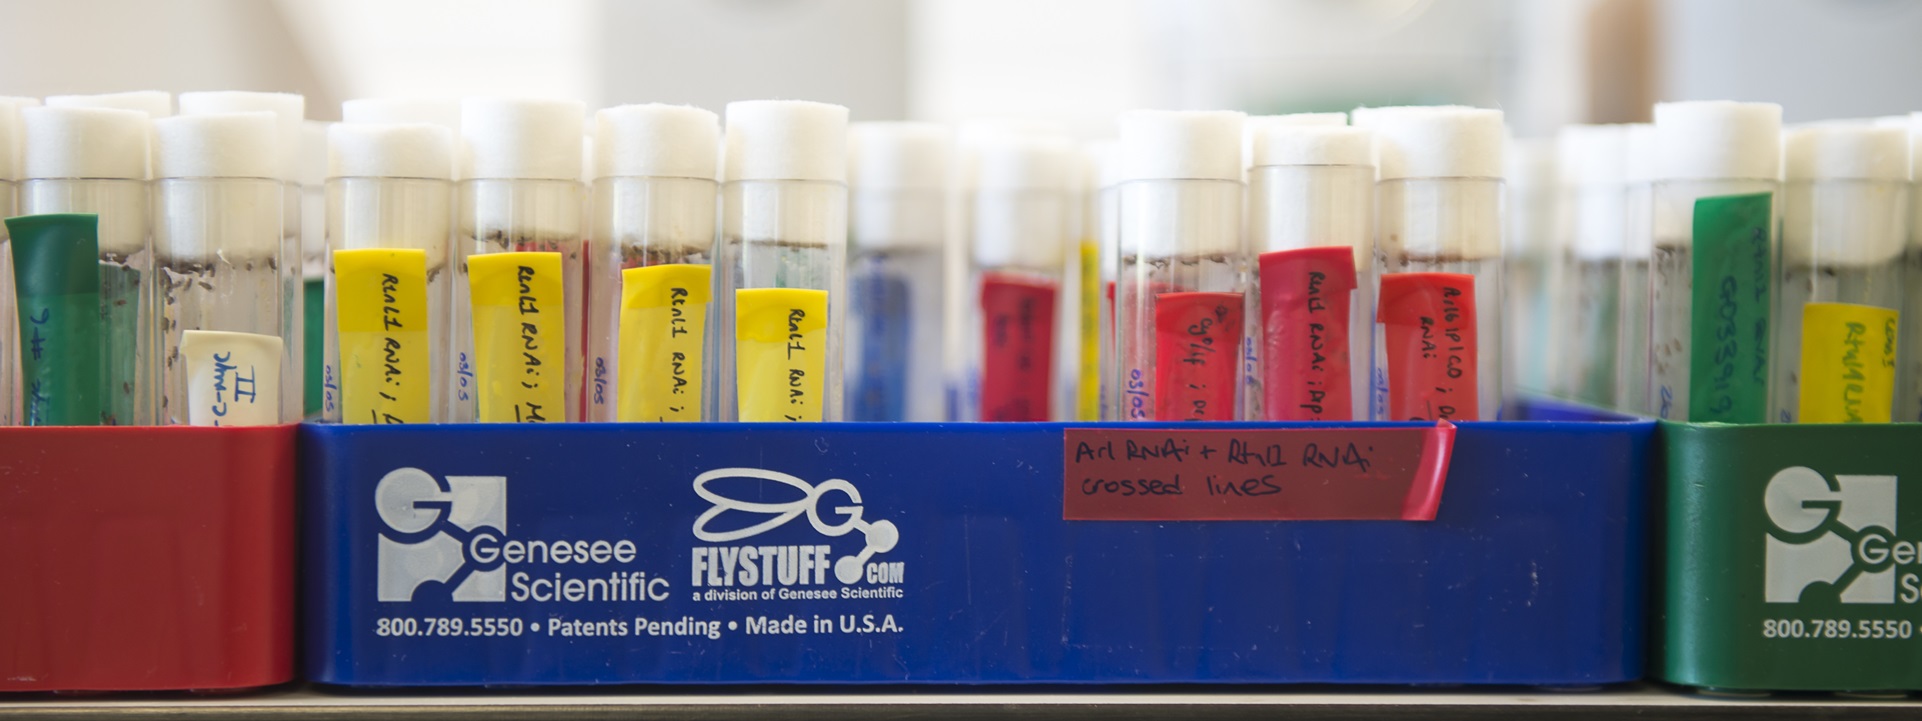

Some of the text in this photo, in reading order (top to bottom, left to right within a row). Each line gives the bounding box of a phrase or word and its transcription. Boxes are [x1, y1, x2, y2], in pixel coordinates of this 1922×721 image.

[669, 287, 689, 338] Rtnl1
[521, 321, 542, 376] RNAi
[787, 308, 806, 360] Rtnl1
[1309, 322, 1328, 373] RNAi
[1419, 316, 1437, 359] RNAi
[382, 336, 402, 387] RNAi
[671, 351, 687, 395] RNAi
[788, 368, 805, 405] RNAi
[1126, 438, 1190, 462] RNAi
[1302, 442, 1375, 472] RNAi
[1082, 474, 1283, 497] crossed lines
[470, 533, 637, 564] Genesee
[692, 545, 831, 587] FLYSTUFF
[510, 571, 670, 602] Scientific
[692, 586, 904, 602] a division of Genesee Scientific
[376, 614, 904, 640] 800.789.5550 Patents Pending Made in U.S.A.
[1763, 619, 1912, 639] 800.789.5550
